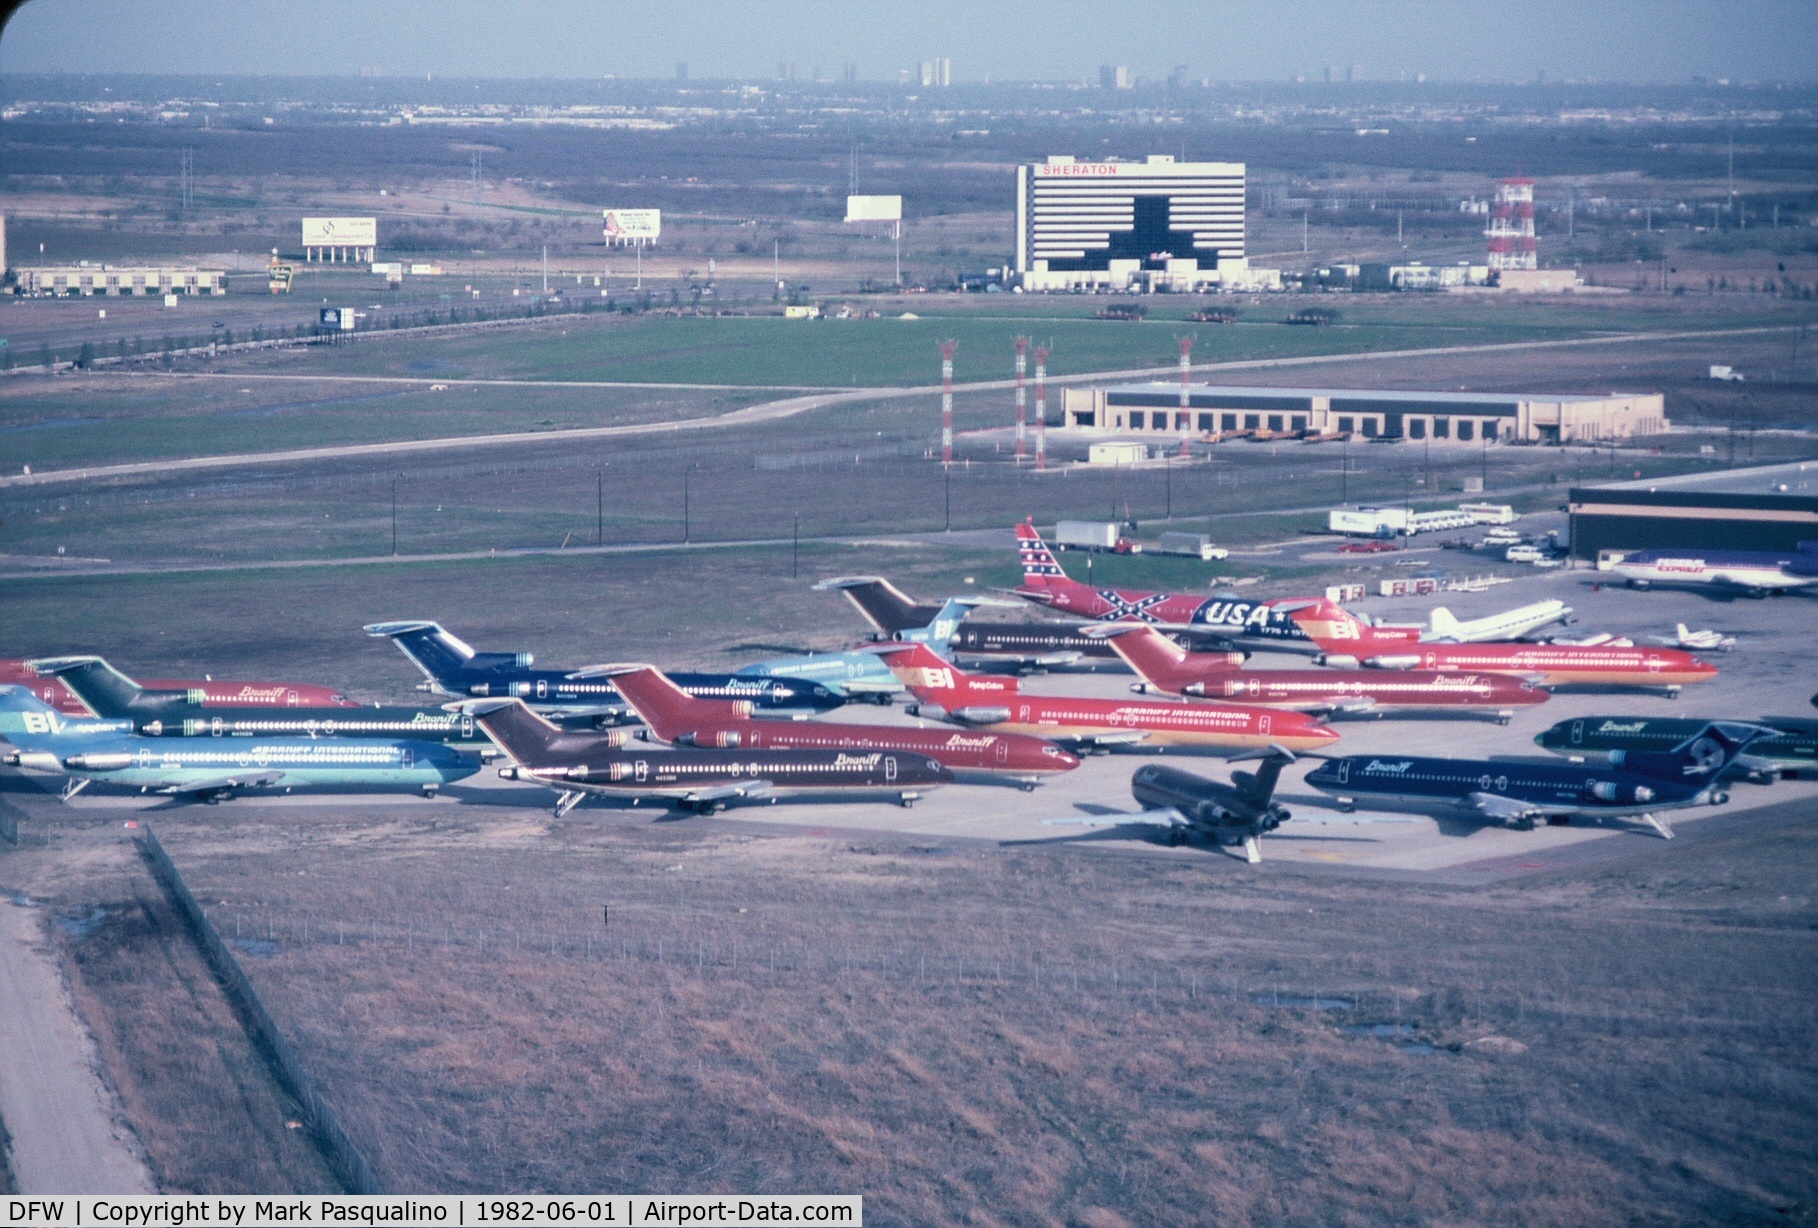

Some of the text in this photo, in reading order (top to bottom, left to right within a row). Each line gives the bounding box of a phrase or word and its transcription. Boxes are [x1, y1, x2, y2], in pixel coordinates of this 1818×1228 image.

[1043, 165, 1117, 175] SHERATON
[1205, 602, 1270, 627] USA
[935, 619, 953, 640] BI
[1261, 627, 1282, 635] 1776
[1328, 618, 1360, 640] BI
[726, 678, 773, 690] Braniff
[922, 667, 955, 689] BI
[1432, 675, 1479, 686] Braniff
[969, 680, 1004, 690] Flying Colors
[239, 686, 284, 697] Braniff
[412, 712, 461, 723] Braniff
[1116, 707, 1252, 719] BRANIFF INTERNATIONAL
[22, 710, 60, 735] BI
[1600, 720, 1648, 732] Braniff
[946, 734, 998, 748] Braniff
[252, 746, 400, 755] BRANIFF INTERNATIONAL
[835, 753, 883, 766] Braniff
[1365, 759, 1414, 773] Braniff
